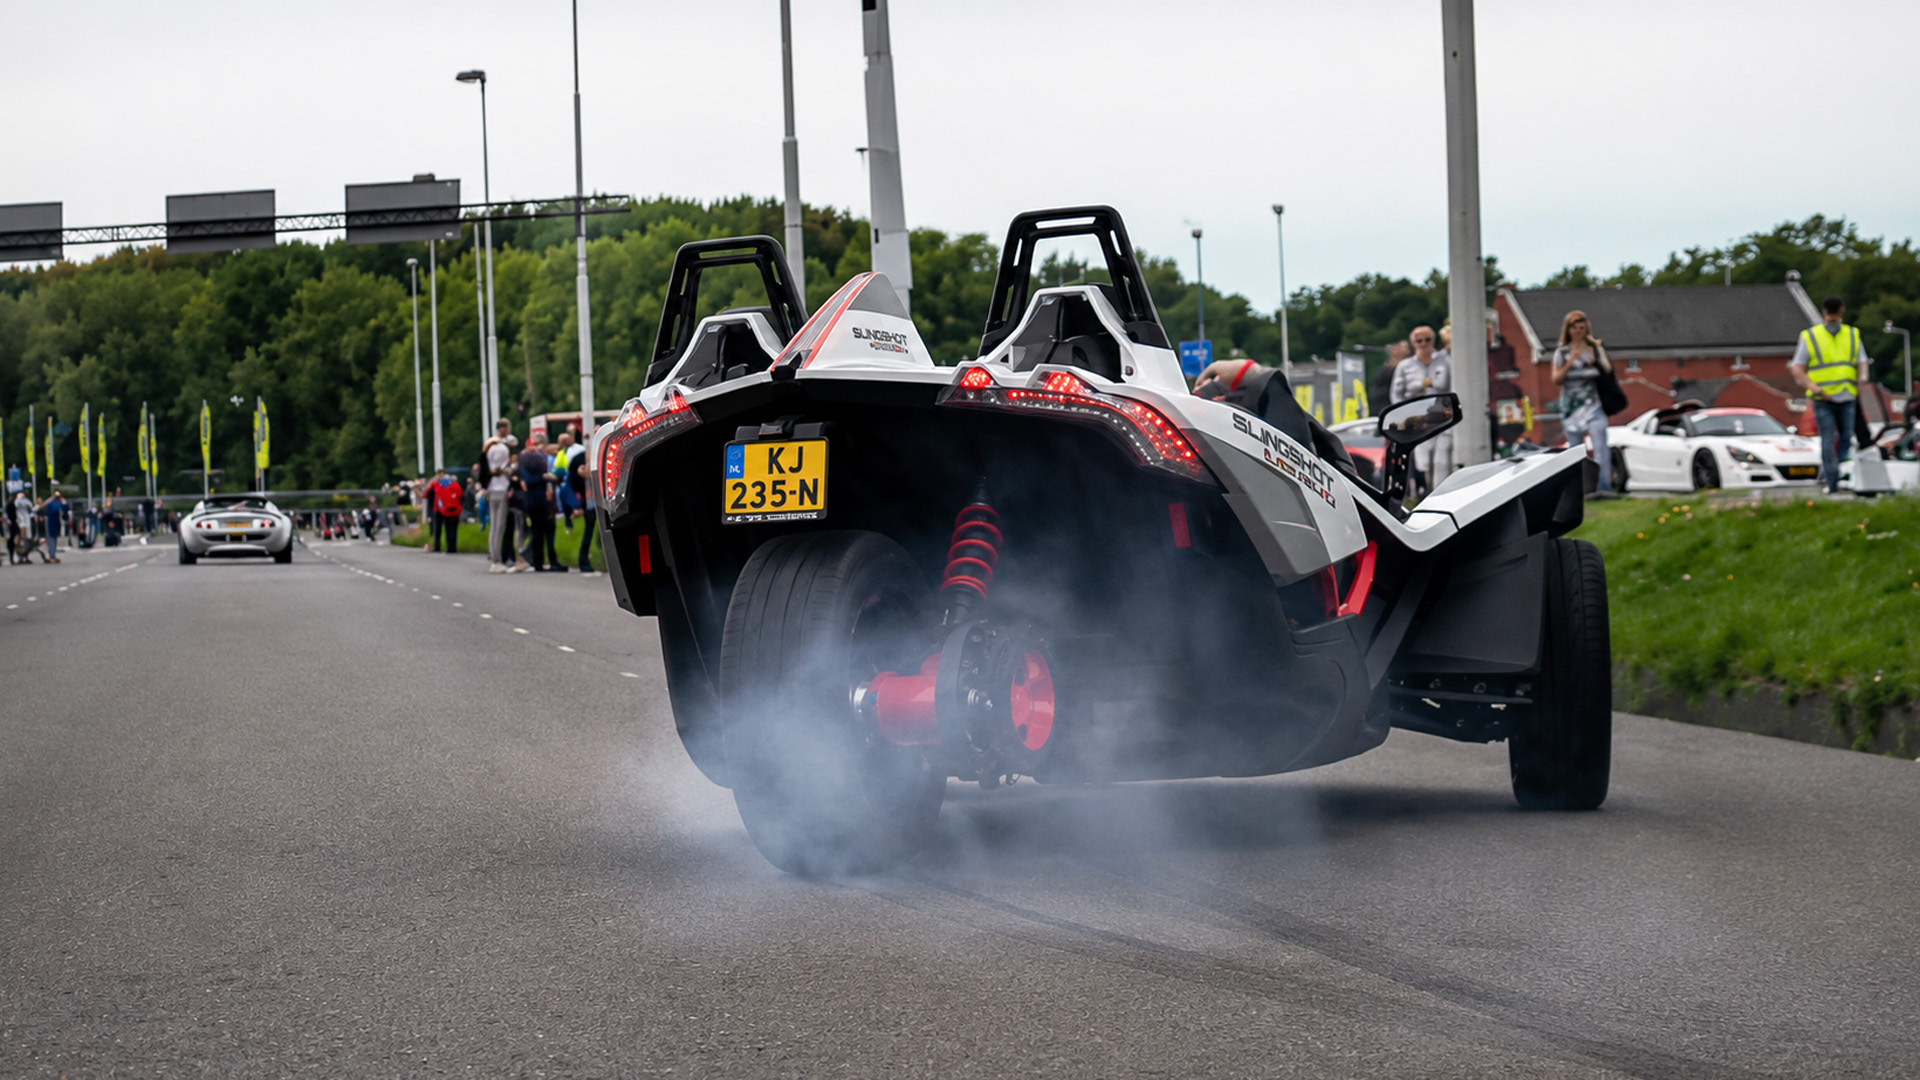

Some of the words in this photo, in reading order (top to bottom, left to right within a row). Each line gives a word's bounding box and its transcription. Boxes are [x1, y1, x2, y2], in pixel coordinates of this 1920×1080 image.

[768, 446, 804, 475] KJ
[1233, 413, 1335, 492] SLINGSHOT
[730, 478, 818, 509] 235-N
